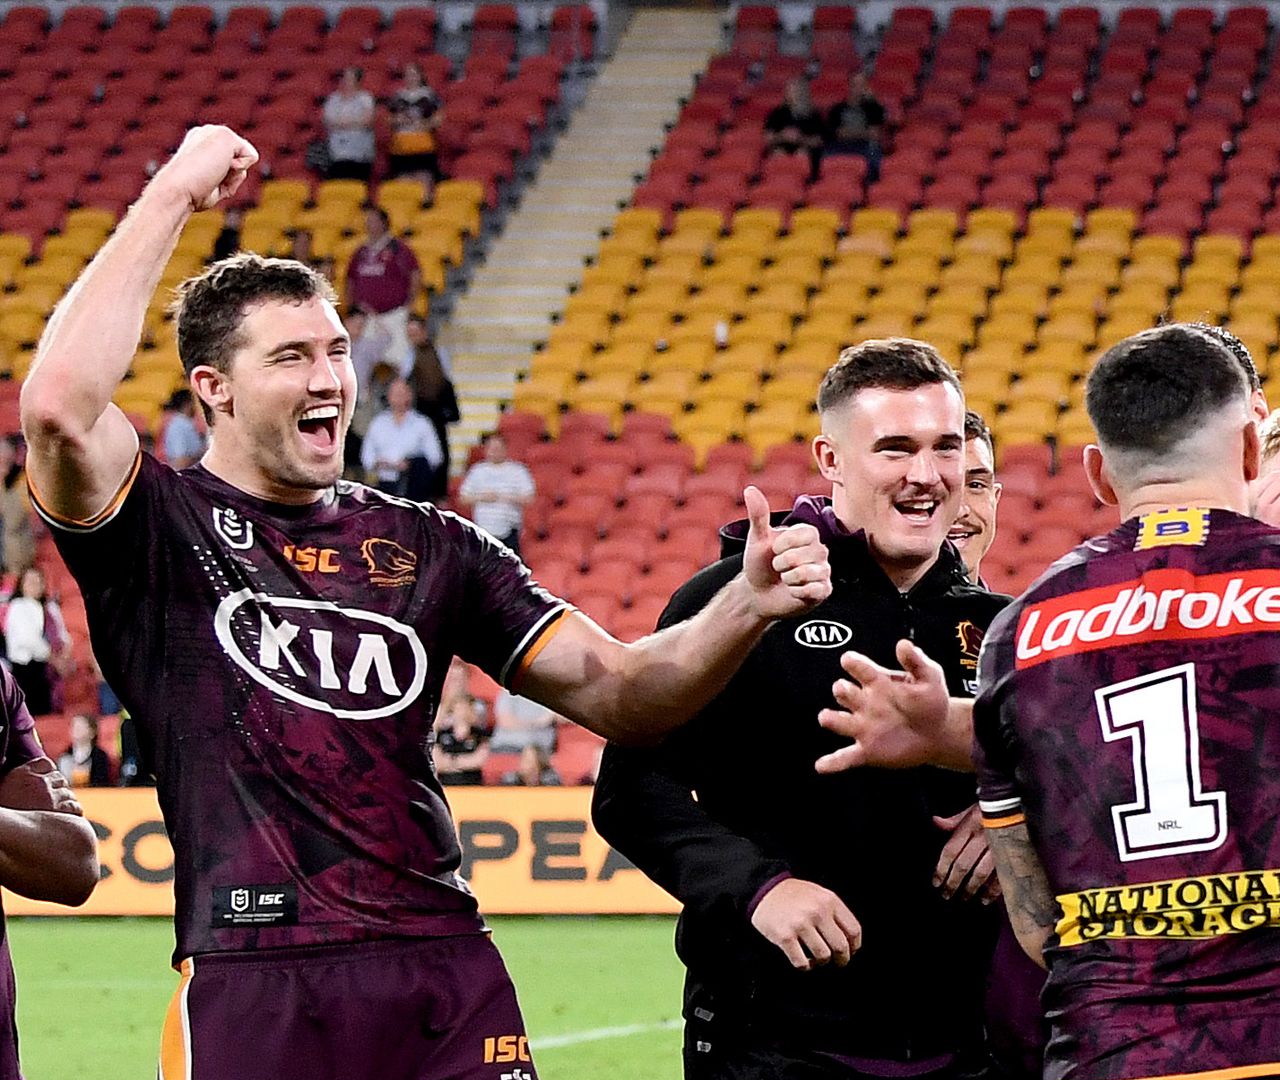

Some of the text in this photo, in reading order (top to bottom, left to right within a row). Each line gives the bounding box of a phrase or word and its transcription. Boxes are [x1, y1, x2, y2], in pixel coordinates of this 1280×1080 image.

[283, 545, 341, 573] ISC
[804, 625, 843, 643] KIA
[259, 608, 402, 697] KIA
[1094, 662, 1228, 862] 1
[1157, 820, 1183, 832] NRL
[258, 893, 285, 906] ISC
[484, 1035, 531, 1064] ISC
